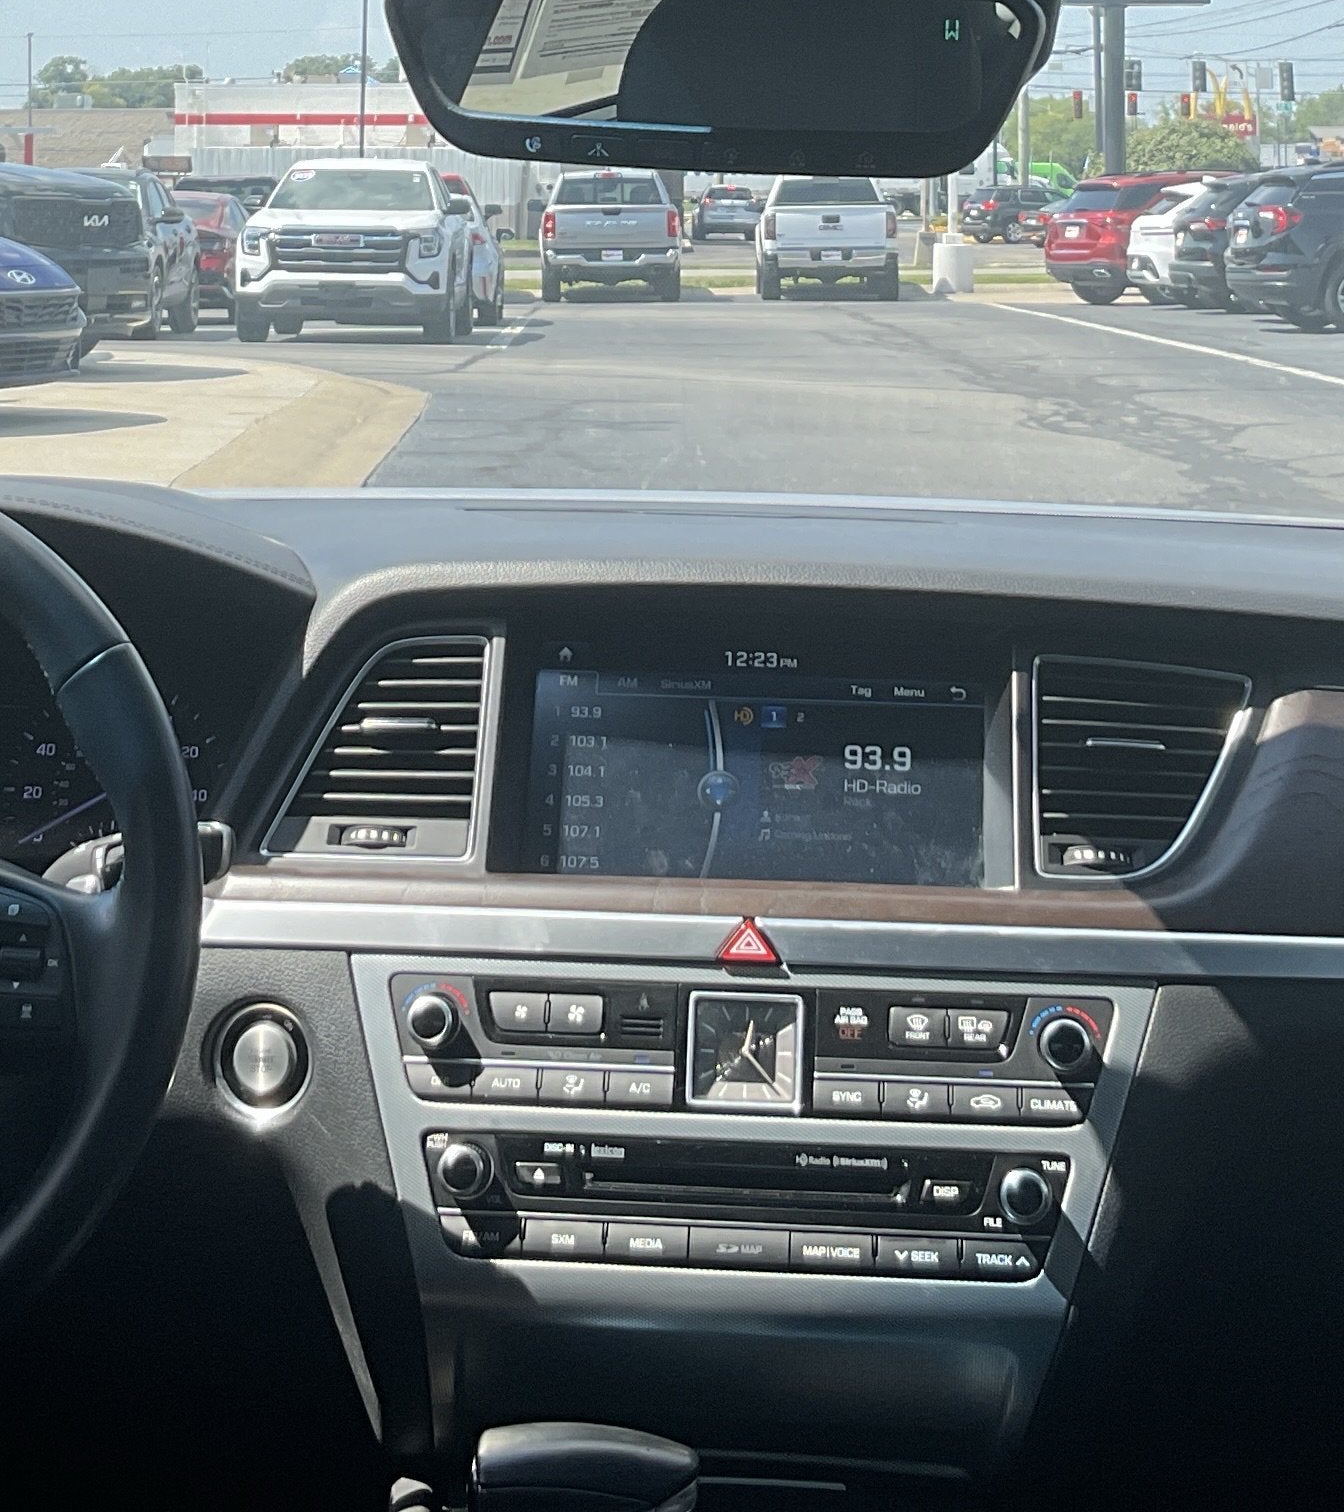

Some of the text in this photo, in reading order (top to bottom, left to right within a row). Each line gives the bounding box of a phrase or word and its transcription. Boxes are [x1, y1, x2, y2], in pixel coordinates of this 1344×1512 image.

[945, 19, 960, 41] W
[559, 675, 579, 687] FM
[616, 677, 639, 688] AM
[850, 684, 926, 698] Tag Menu
[570, 705, 603, 719] 93.9
[36, 743, 56, 756] 40
[843, 744, 913, 772] 93.9
[567, 763, 606, 778] 104.1
[23, 786, 43, 799] 20
[843, 778, 923, 796] HD-Radio
[544, 793, 605, 808] 4 105.3
[542, 823, 601, 838] 5 107.1
[559, 854, 600, 870] 107.5
[839, 1027, 862, 1039] OFF
[905, 1031, 930, 1040] FRONT
[491, 1076, 521, 1089] AUTO
[628, 1081, 651, 1094] A/C
[832, 1089, 862, 1103] SYNC
[1030, 1097, 1078, 1112] CLIMATE
[1041, 1160, 1066, 1171] TUNE
[932, 1185, 959, 1197] DISP
[551, 1234, 575, 1245] SXM
[629, 1238, 663, 1250] MEDIA
[910, 1250, 939, 1263] SEEK
[975, 1252, 1013, 1266] TRACK
